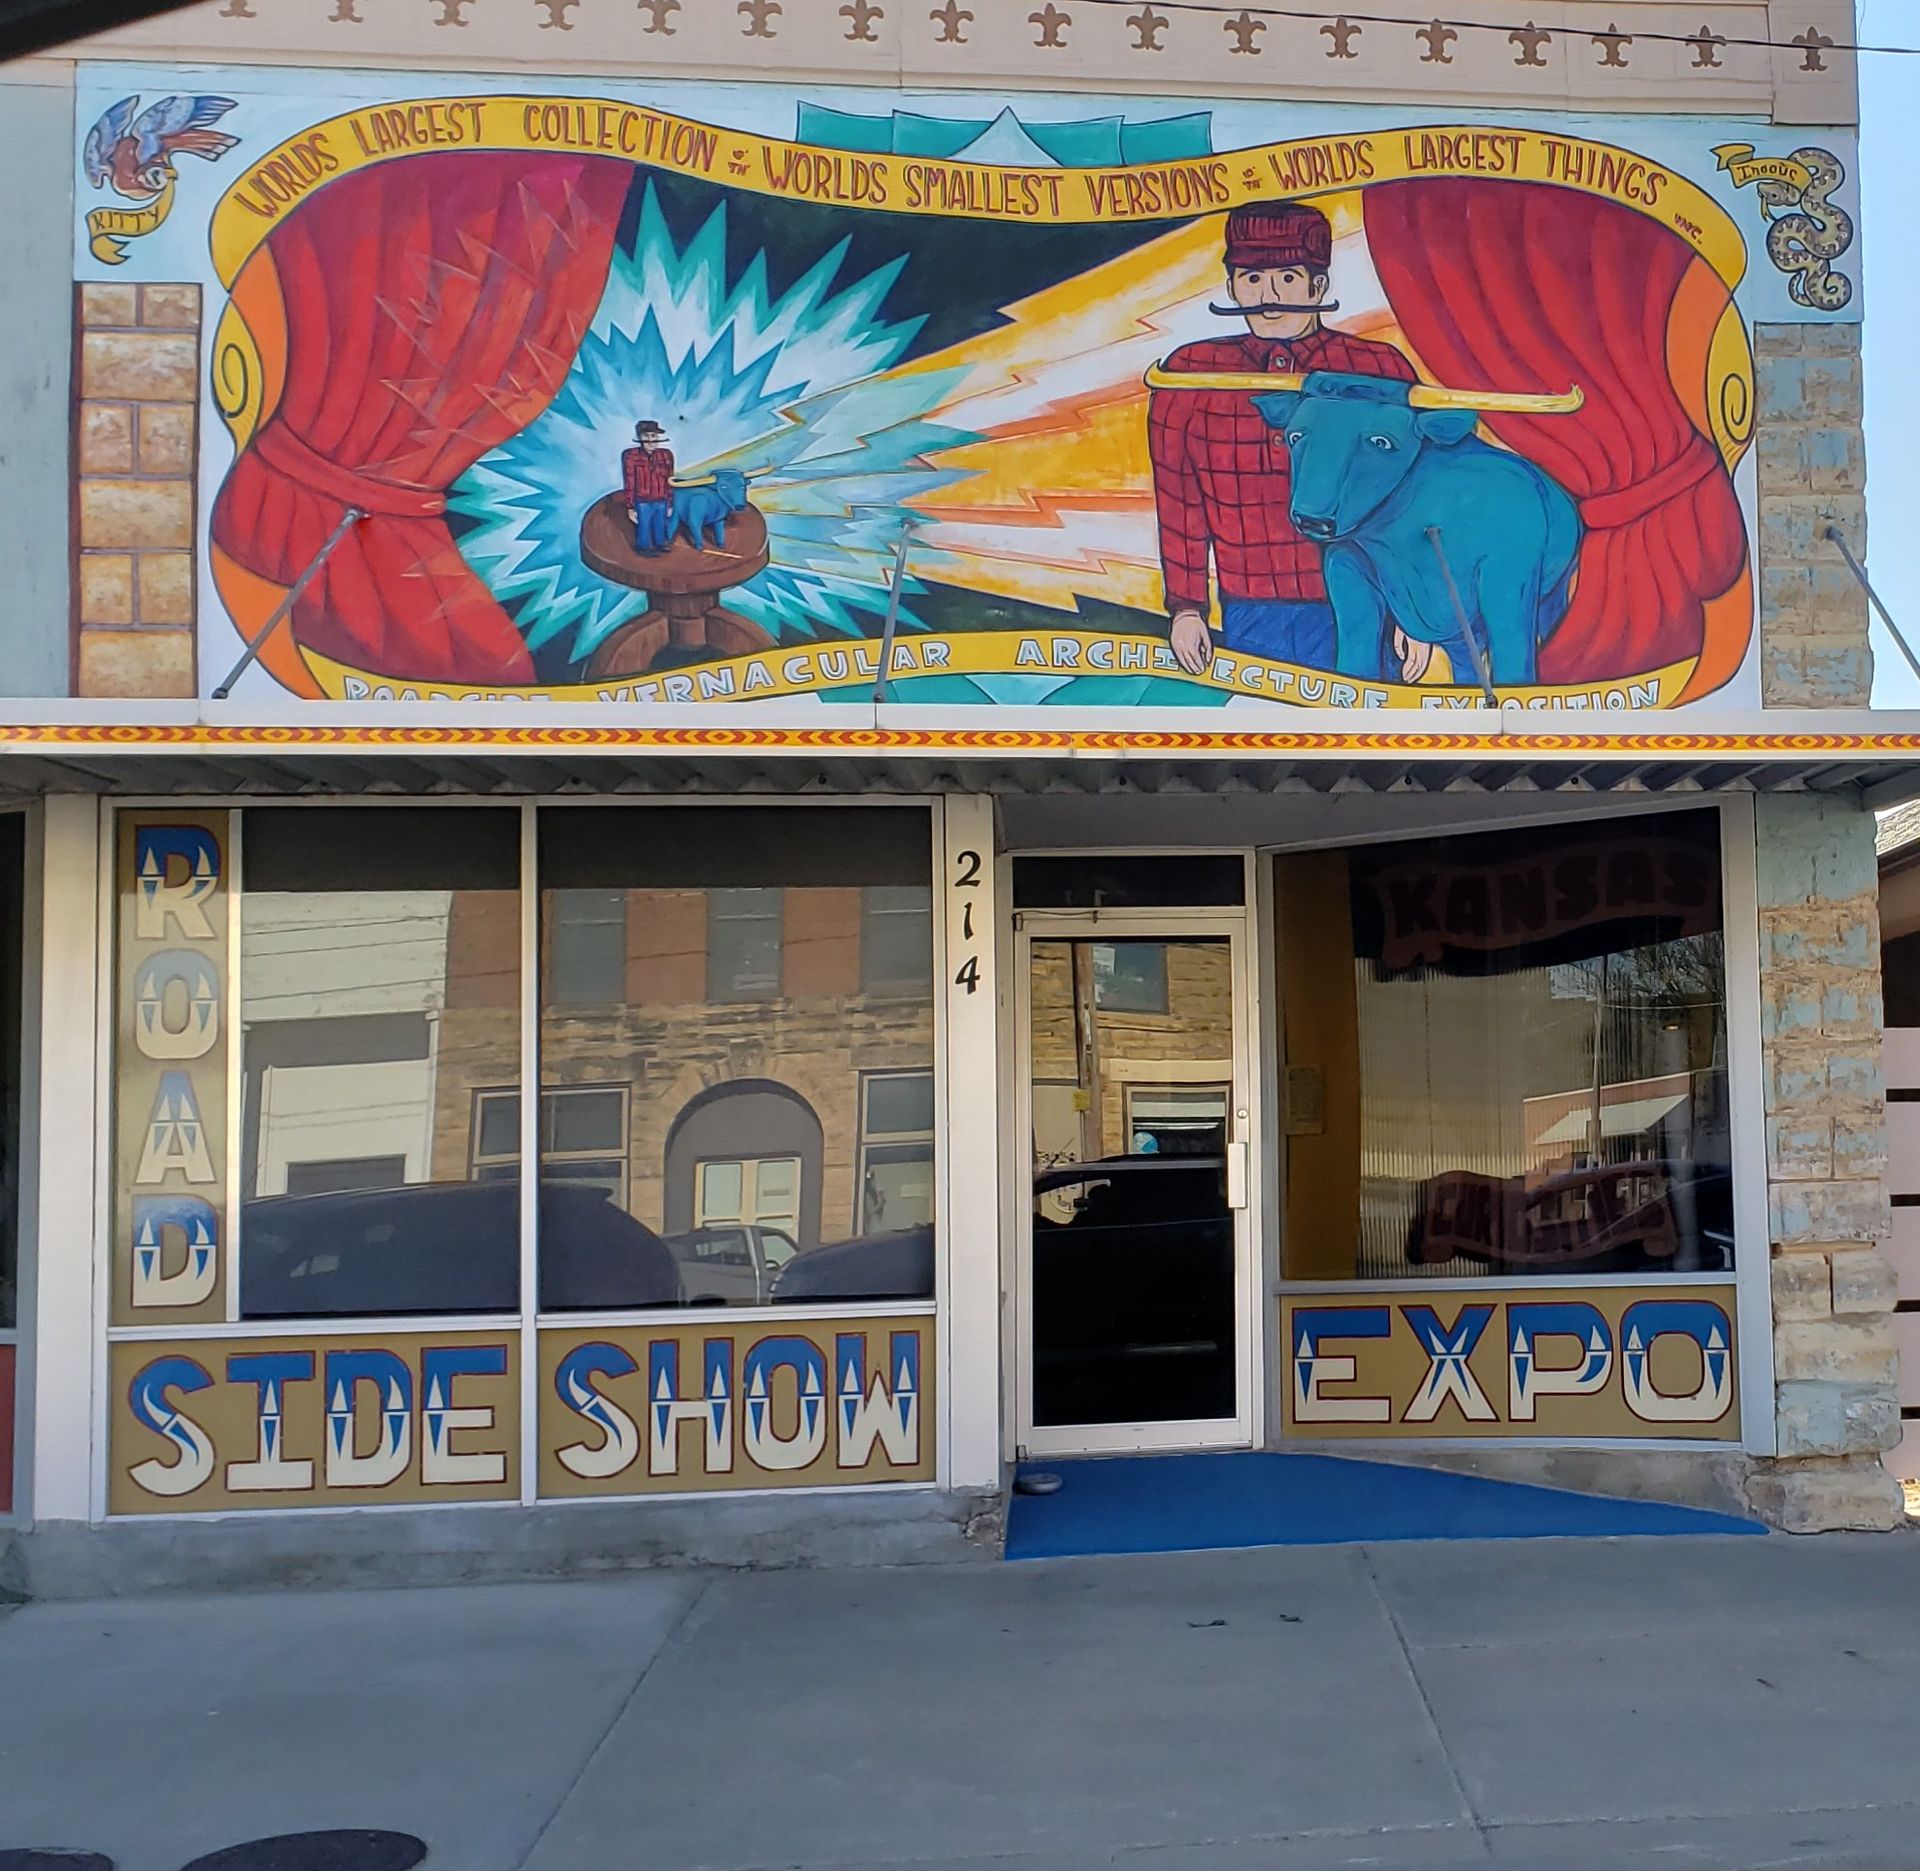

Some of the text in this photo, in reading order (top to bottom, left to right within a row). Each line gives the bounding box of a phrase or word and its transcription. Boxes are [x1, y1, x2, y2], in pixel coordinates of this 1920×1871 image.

[91, 204, 159, 232] KITTY
[235, 133, 340, 218] WORLDS
[350, 103, 487, 157] LARGEST
[523, 105, 719, 173] COLLECTION
[761, 145, 888, 203] WORLDS
[903, 164, 1064, 217] SMALLEST
[1084, 162, 1230, 217] VERSIONS
[1267, 138, 1375, 191] WORLDS
[1403, 134, 1527, 174] LARGEST
[1540, 139, 1668, 208] THINGS
[1015, 637, 1389, 709] ARCHIECTURE
[954, 850, 982, 995] 214
[1386, 848, 1713, 939] KANSAS
[131, 824, 221, 1309] ROAD
[128, 1330, 921, 1496] SIDE SHOW
[1292, 1300, 1732, 1424] EXPO
